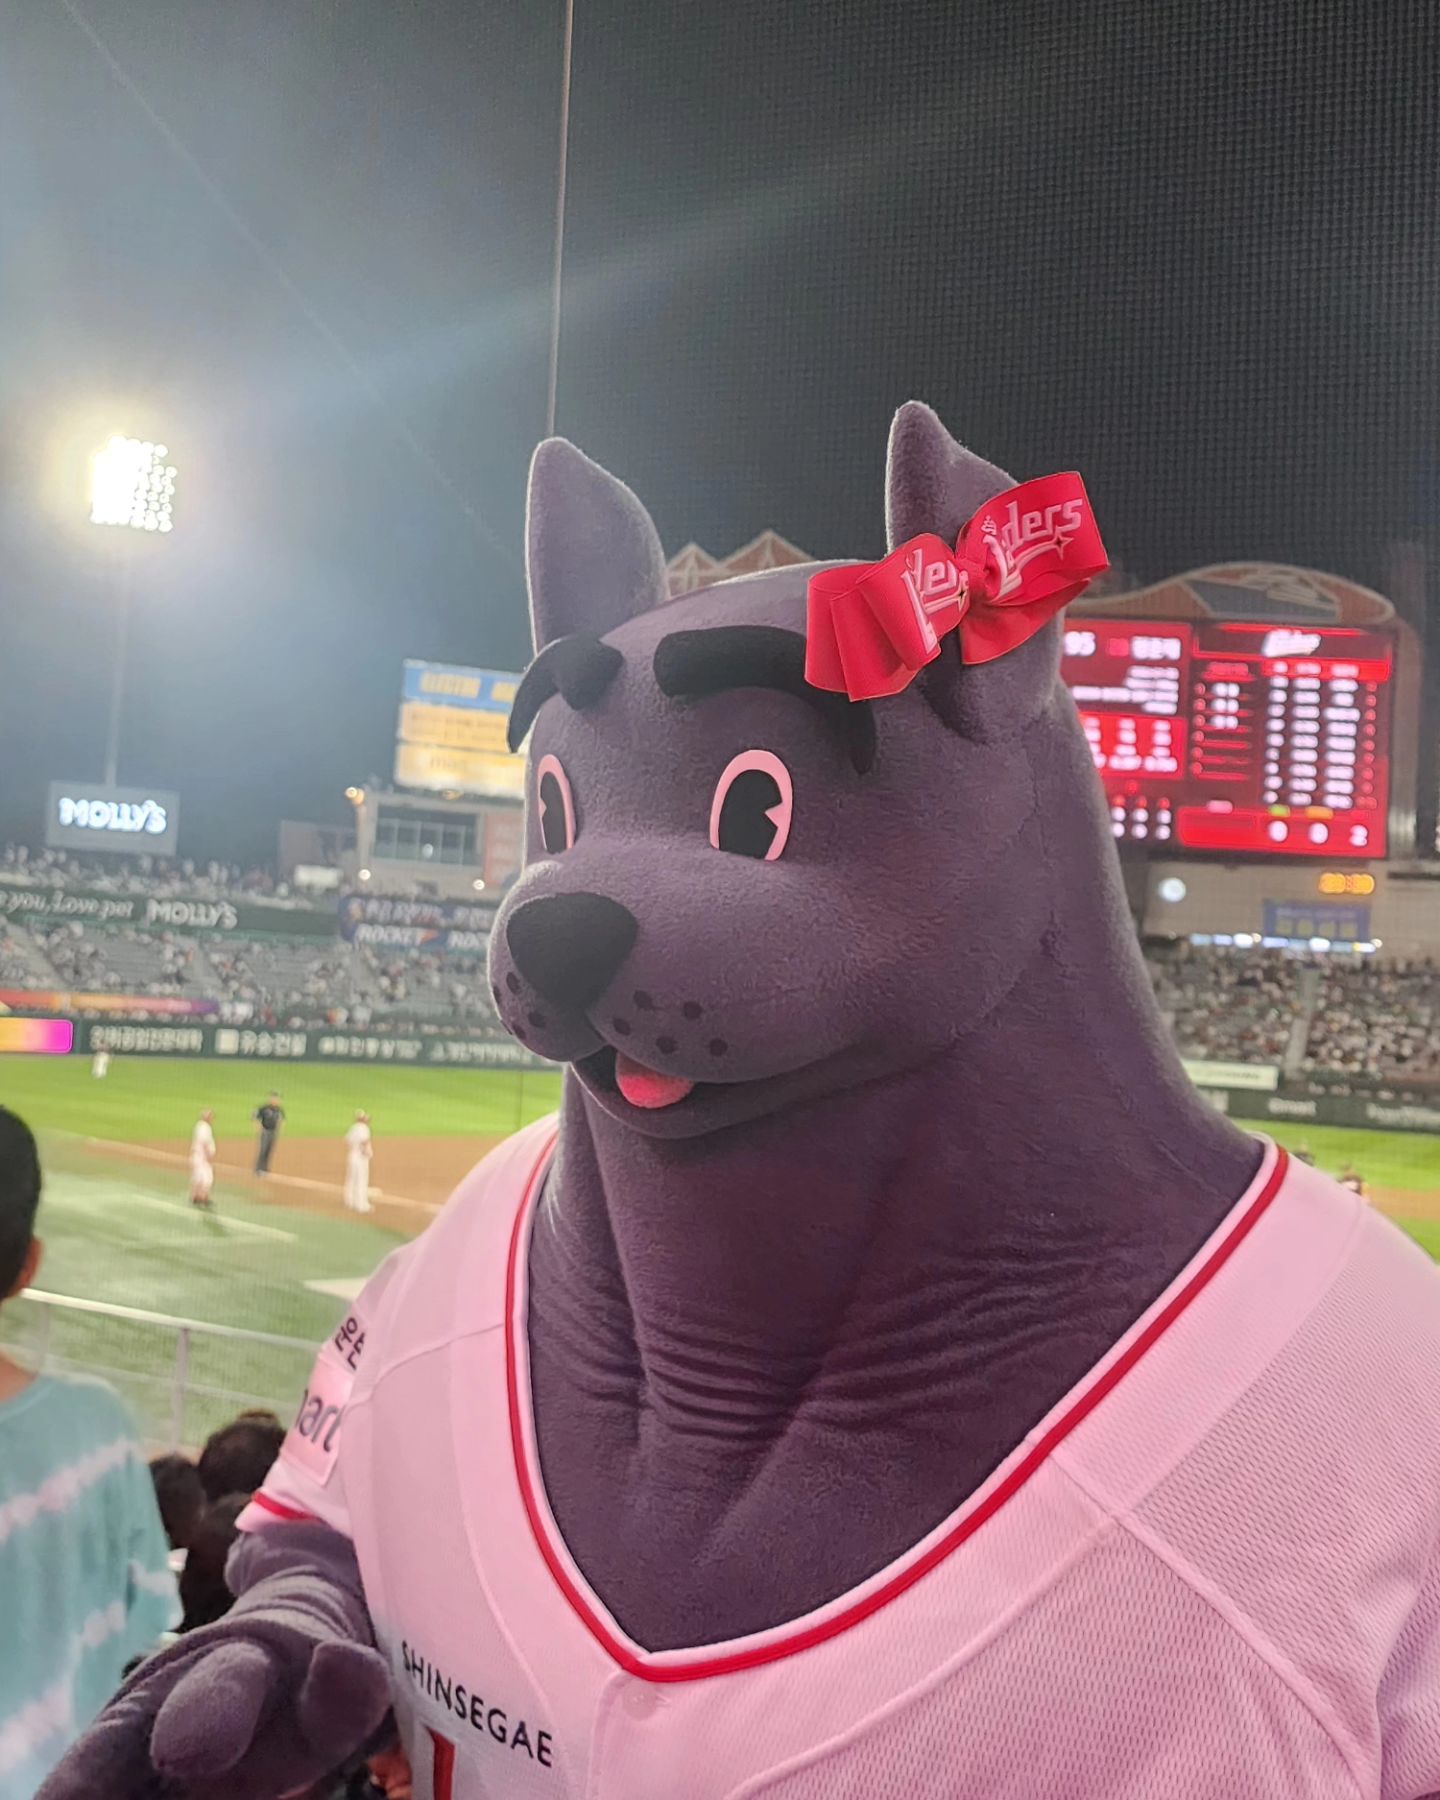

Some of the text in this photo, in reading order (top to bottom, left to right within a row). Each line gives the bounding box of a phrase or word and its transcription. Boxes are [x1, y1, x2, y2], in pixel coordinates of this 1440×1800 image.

[59, 797, 166, 833] MOLLY'S
[146, 898, 238, 929] MOLLY'S
[295, 1388, 346, 1452] art
[402, 1640, 552, 1768] SHINSEGAE
